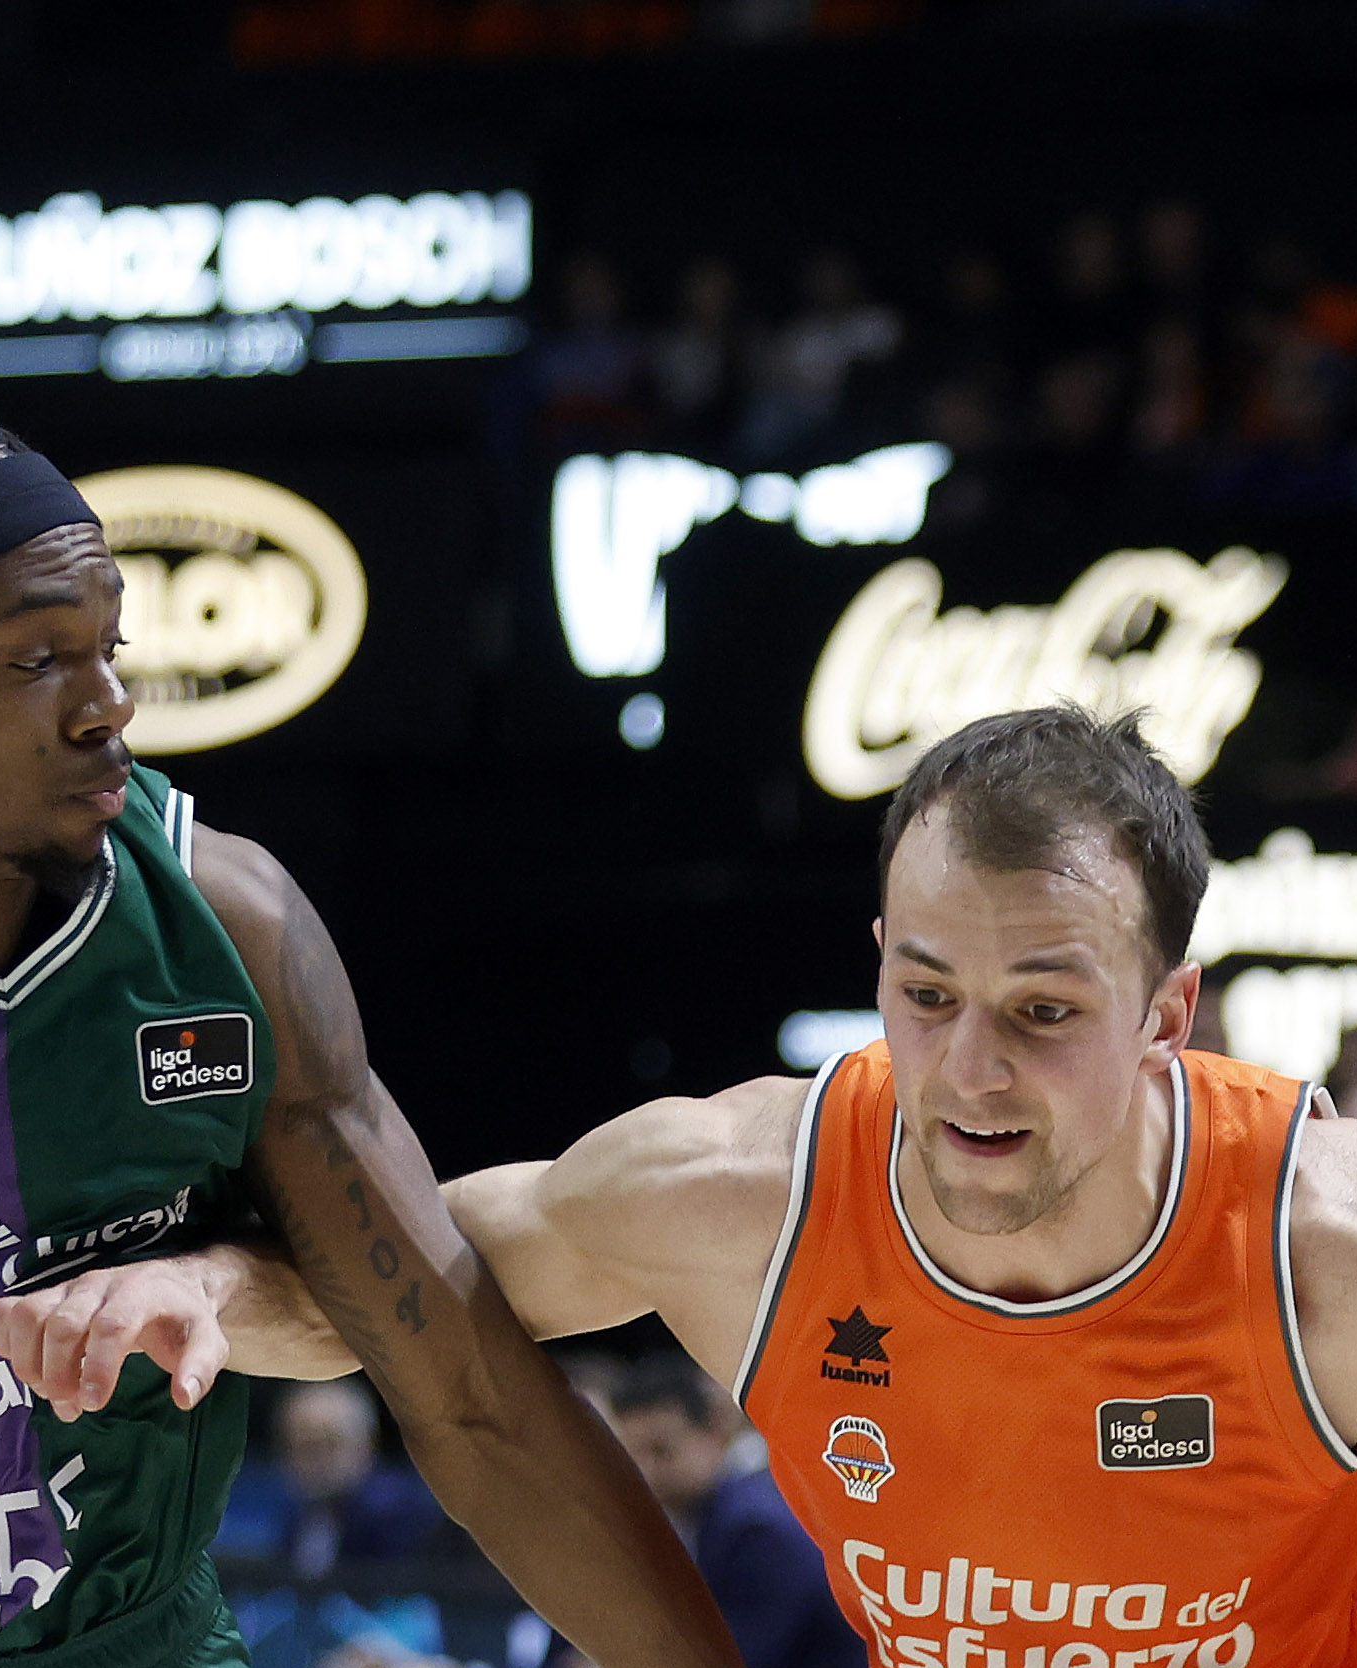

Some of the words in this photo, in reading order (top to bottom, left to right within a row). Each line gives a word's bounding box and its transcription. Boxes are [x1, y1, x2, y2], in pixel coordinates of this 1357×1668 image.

[150, 1048, 192, 1072] liga
[151, 1064, 243, 1091] endesa
[1109, 1420, 1154, 1444] liga
[1111, 1439, 1204, 1460] endesa
[843, 1538, 1167, 1631] Cultura
[1175, 1576, 1252, 1628] del
